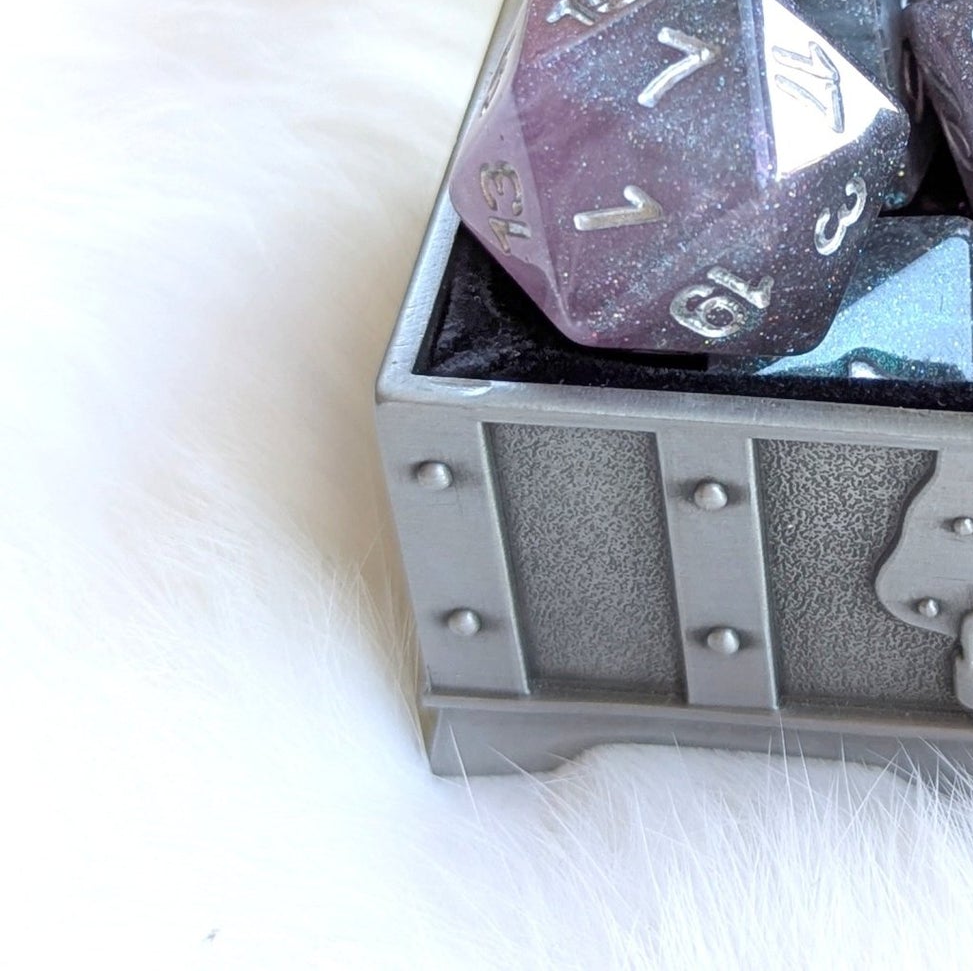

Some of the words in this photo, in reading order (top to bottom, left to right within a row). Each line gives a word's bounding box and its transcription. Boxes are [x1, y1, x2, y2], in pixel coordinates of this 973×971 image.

[637, 27, 722, 109] 7
[573, 184, 664, 232] 1
[814, 175, 867, 256] 3
[669, 265, 775, 338] 19
